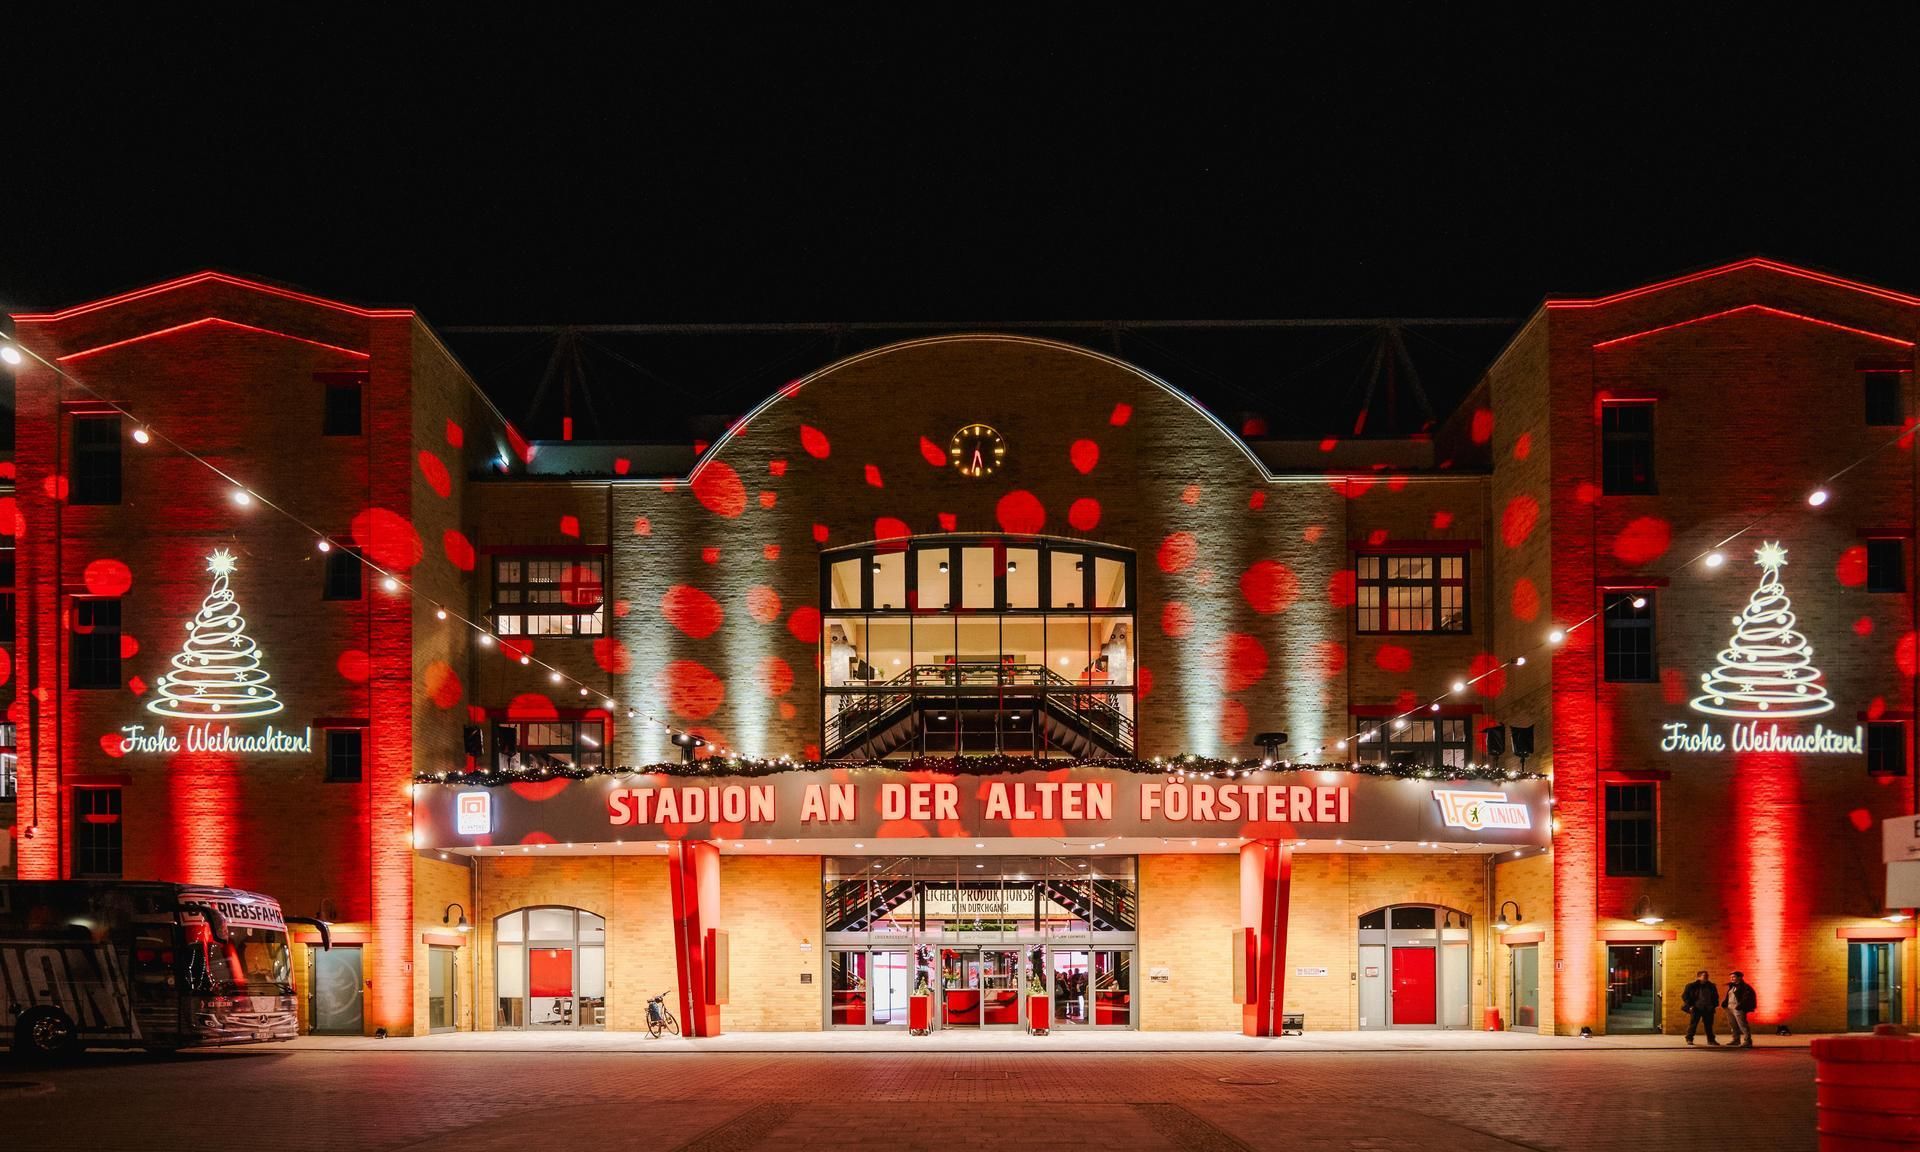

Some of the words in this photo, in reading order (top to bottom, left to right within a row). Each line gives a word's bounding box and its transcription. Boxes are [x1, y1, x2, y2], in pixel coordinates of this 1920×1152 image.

[120, 724, 180, 753] Frohe
[187, 722, 312, 753] Weihnachten!
[1661, 722, 1725, 752] Frohe
[1732, 720, 1864, 754] Weihnachten!
[608, 784, 776, 825] STADION
[800, 783, 857, 822] AN
[881, 783, 960, 820] DER
[985, 782, 1113, 820] ALTEN
[1140, 776, 1350, 823] FÖRSTEREI
[1489, 807, 1527, 825] UNION
[951, 904, 967, 913] KIN
